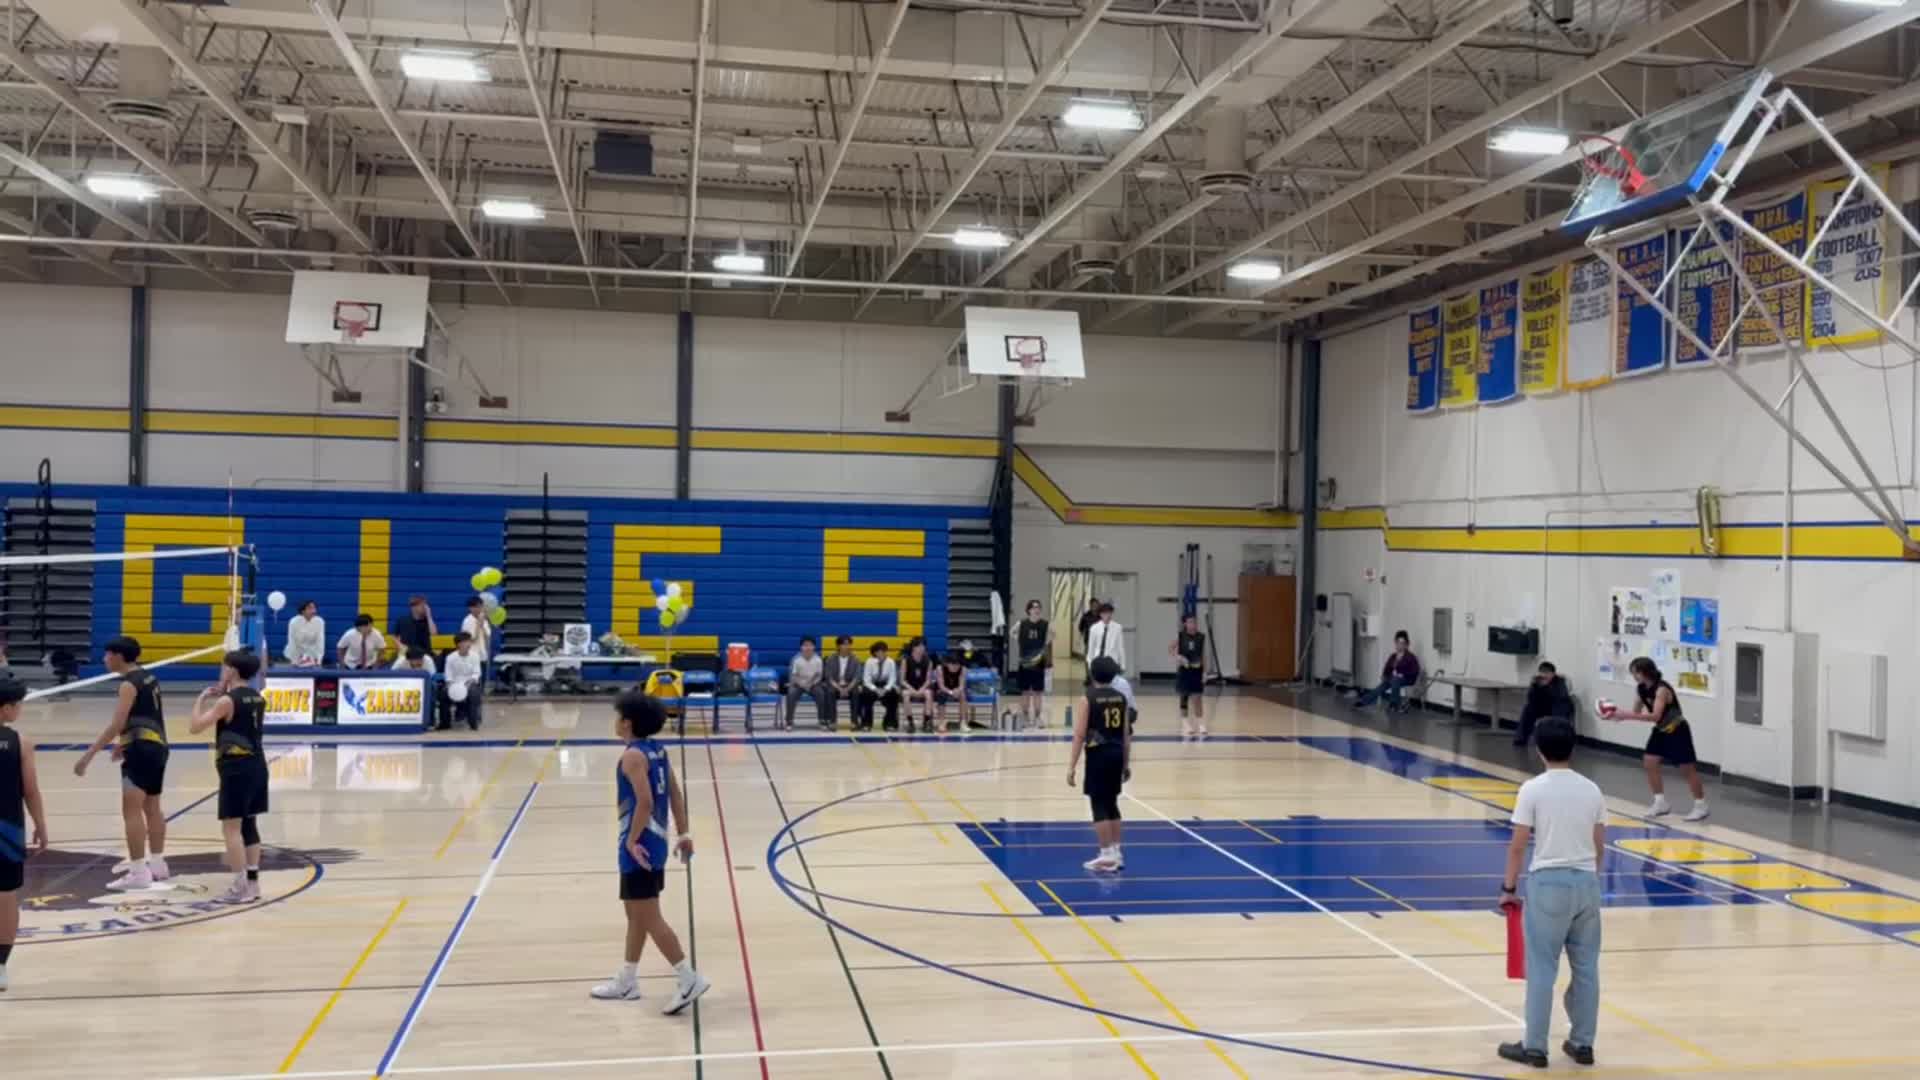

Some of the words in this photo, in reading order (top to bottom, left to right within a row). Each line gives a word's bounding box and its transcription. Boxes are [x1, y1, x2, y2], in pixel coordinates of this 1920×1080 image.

[1814, 204, 1883, 233] CAMPIONS
[1815, 228, 1879, 258] FOOTBALL
[366, 688, 421, 713] EAGLES
[1104, 708, 1120, 728] 13
